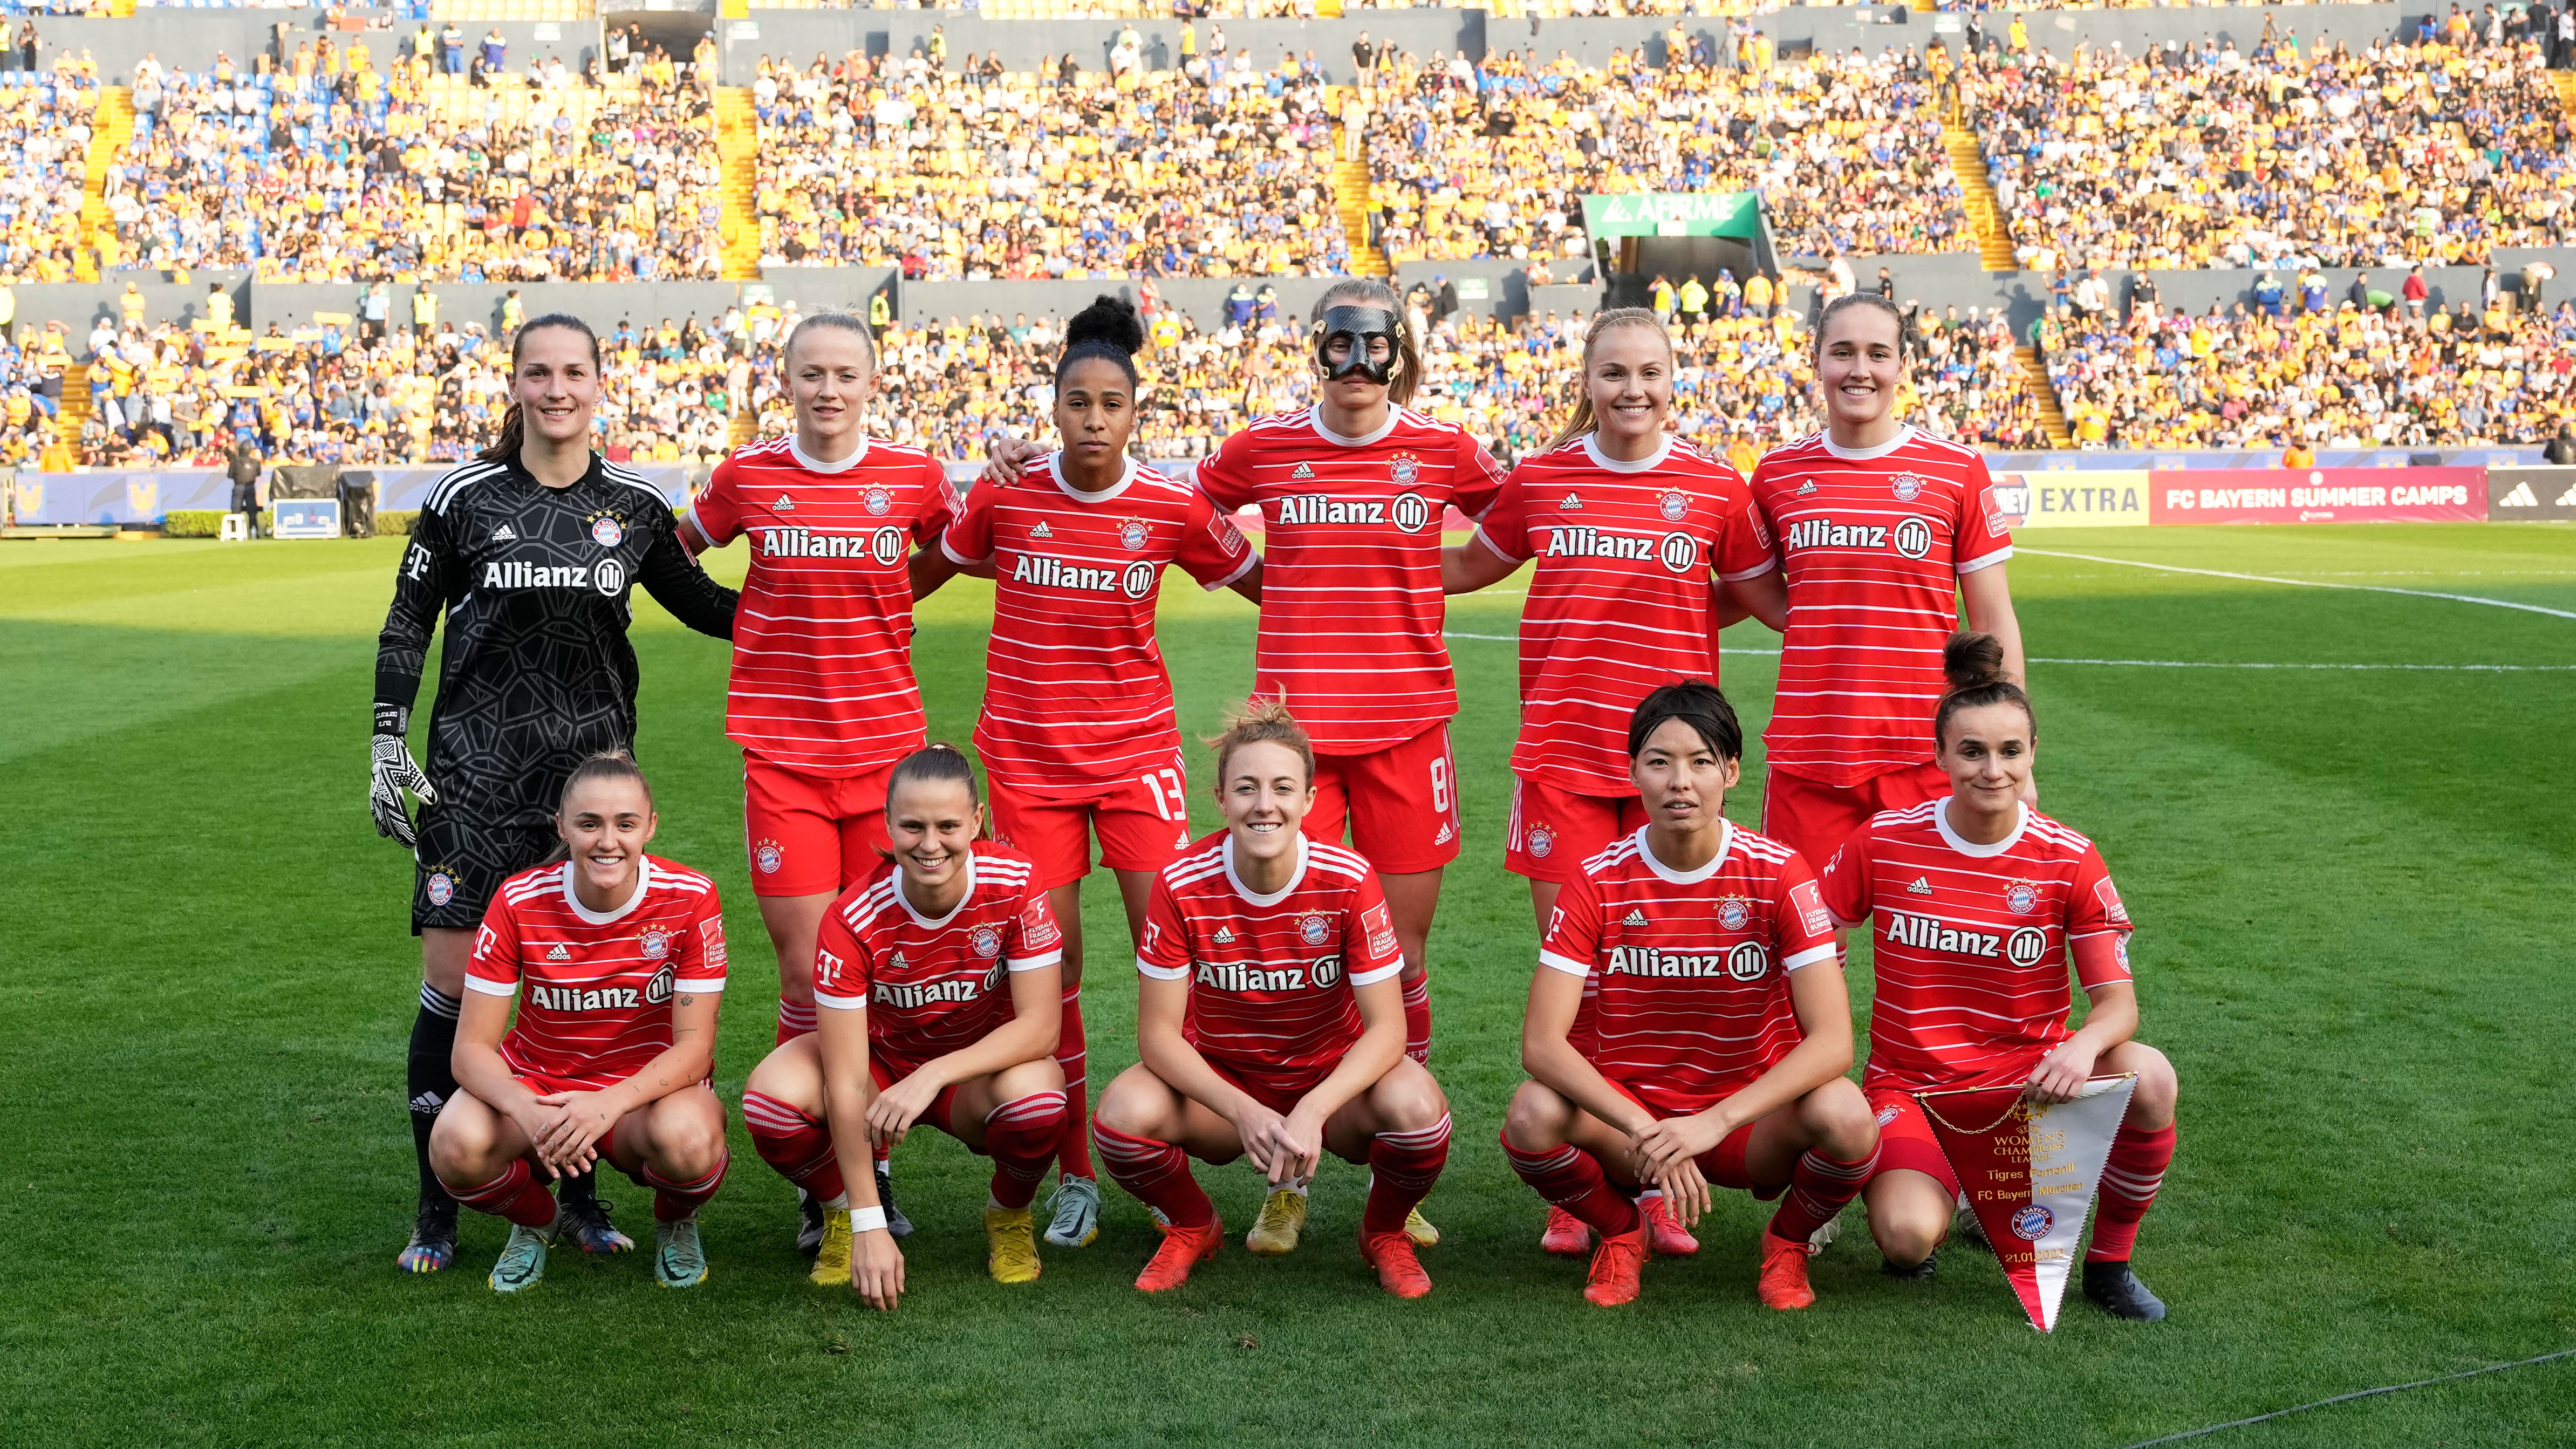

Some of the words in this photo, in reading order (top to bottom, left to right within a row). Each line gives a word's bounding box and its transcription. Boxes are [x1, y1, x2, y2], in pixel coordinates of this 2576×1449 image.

[1637, 194, 1734, 221] AFIRME
[1292, 471, 1315, 479] adidas
[1796, 485, 1818, 495] adidas
[2041, 488, 2139, 512] EXTRA
[2167, 489, 2195, 509] FC
[2201, 488, 2285, 508] BAYERN
[2291, 486, 2386, 507] SUMMER
[2391, 484, 2468, 505] CAMPS
[772, 503, 795, 511] adidas
[1279, 495, 1385, 525] Allianz
[1559, 502, 1583, 510] adidas
[763, 528, 865, 558] Allianz
[1546, 527, 1654, 562] Allianz
[1788, 518, 1887, 553] Allianz
[483, 561, 588, 589] Allianz
[1013, 554, 1116, 592] Allianz
[1141, 768, 1186, 821] 13
[1430, 756, 1448, 813] 8
[1907, 885, 1933, 895] adidas
[1622, 918, 1648, 926] adidas
[1212, 935, 1236, 944] adidas
[1886, 913, 2001, 958] Allianz
[818, 948, 843, 987] T
[889, 960, 909, 969] adidas
[1605, 945, 1721, 978] Allianz
[1195, 962, 1307, 992] Allianz
[531, 986, 640, 1011] Allianz
[873, 979, 979, 1009] Allianz
[1994, 1130, 2066, 1146] WOMEN'S
[2017, 1126, 2040, 1134] UEFA
[1993, 1141, 2066, 1156] CHAMPIONS
[2012, 1154, 2050, 1163] LEAGUE
[1986, 1170, 2024, 1181] Tigres
[1978, 1191, 1993, 1200] FC
[1998, 1190, 2034, 1201] Bayern
[2038, 1182, 2085, 1197] München
[2022, 1207, 2050, 1219] BAYERN
[2015, 1224, 2051, 1239] MÜNCHEN
[2005, 1248, 2065, 1263] 21.01.2023
